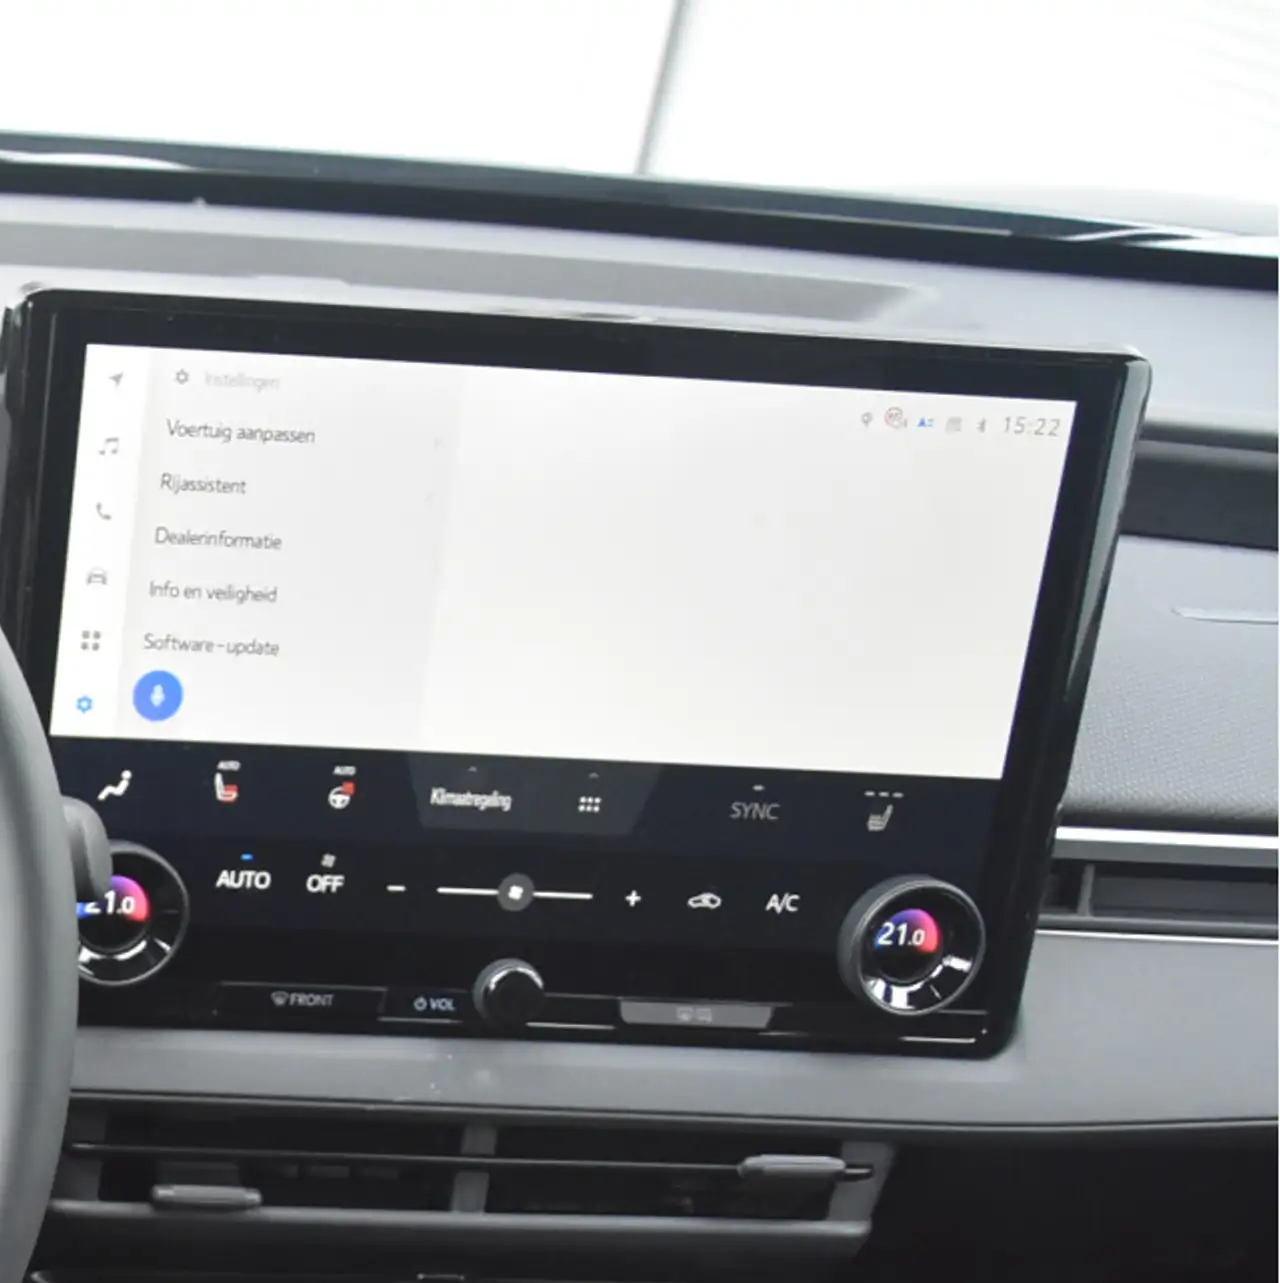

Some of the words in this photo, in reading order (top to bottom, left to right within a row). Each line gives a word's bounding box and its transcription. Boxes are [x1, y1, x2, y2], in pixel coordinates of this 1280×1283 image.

[205, 370, 279, 392] Instellingen
[166, 419, 232, 442] Voertuig
[236, 424, 316, 444] aanpassen
[1002, 416, 1061, 437] 15:22
[159, 472, 247, 495] Rijassistent
[154, 526, 283, 551] Dealerinformatie
[148, 580, 180, 599] Info
[183, 585, 202, 600] en
[206, 584, 278, 605] veiligheid
[143, 633, 279, 656] Software-update
[217, 760, 241, 771] AUTO
[333, 765, 356, 776] AUTO
[729, 801, 780, 822] SYNC
[215, 870, 272, 891] AUTO
[306, 874, 345, 894] OFF
[766, 893, 800, 914] A/C
[877, 921, 926, 948] 21.0
[289, 992, 334, 1008] FRONT
[428, 998, 456, 1011] VOL
